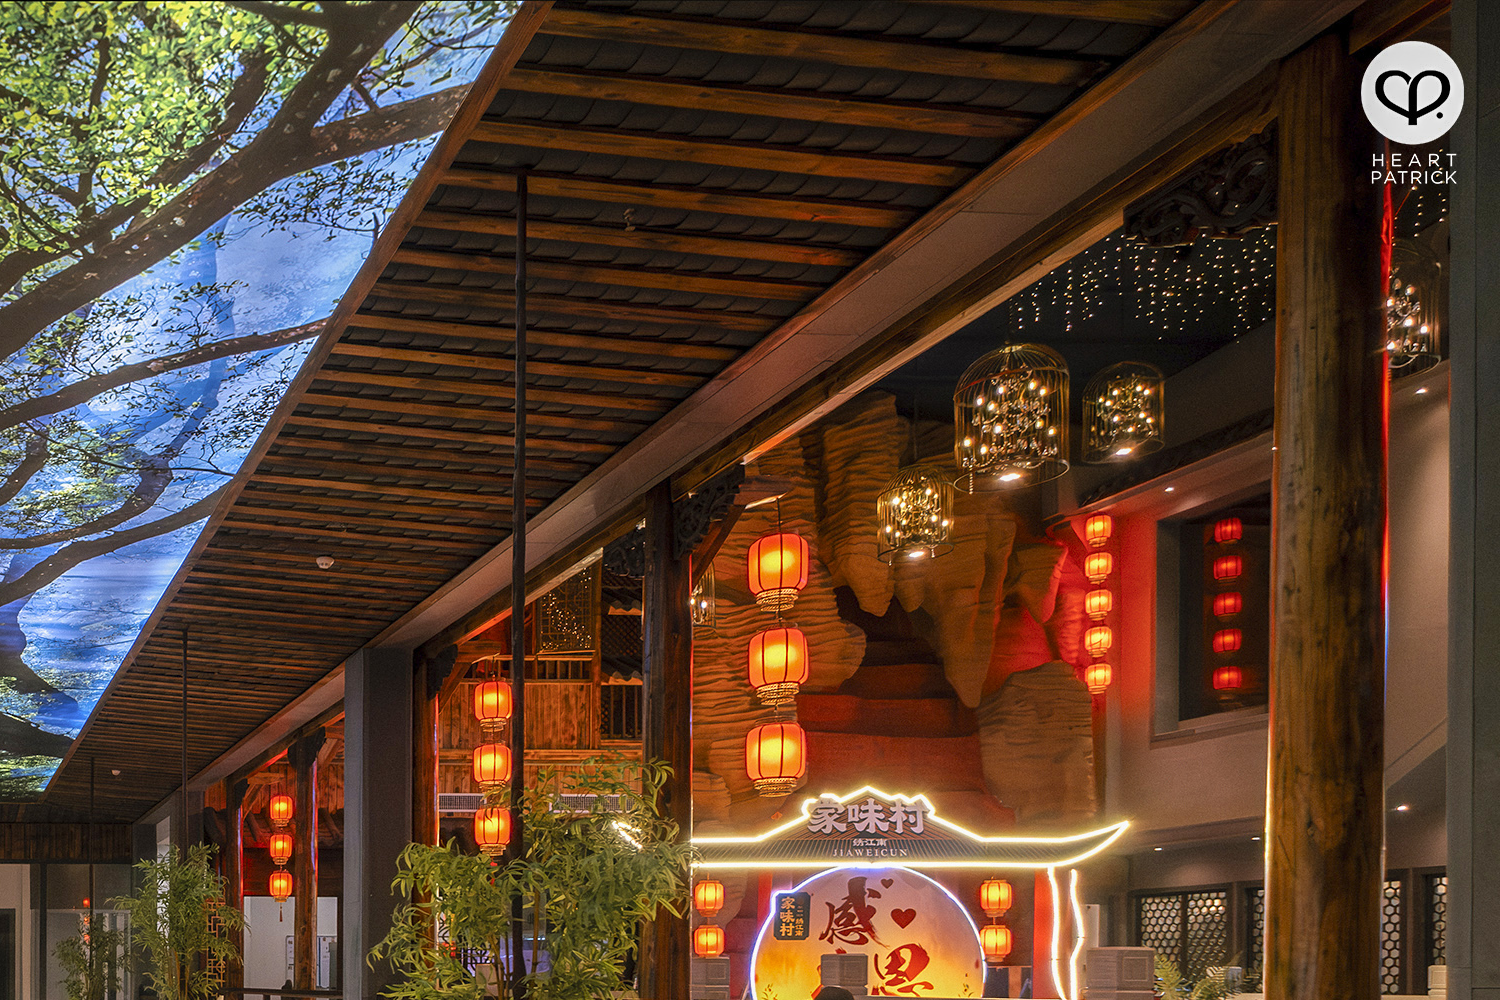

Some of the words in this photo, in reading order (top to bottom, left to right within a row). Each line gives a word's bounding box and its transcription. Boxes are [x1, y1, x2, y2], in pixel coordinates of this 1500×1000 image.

[808, 797, 930, 834] 家味村
[833, 848, 908, 857] JIAWEICUN
[779, 896, 795, 937] 家味村
